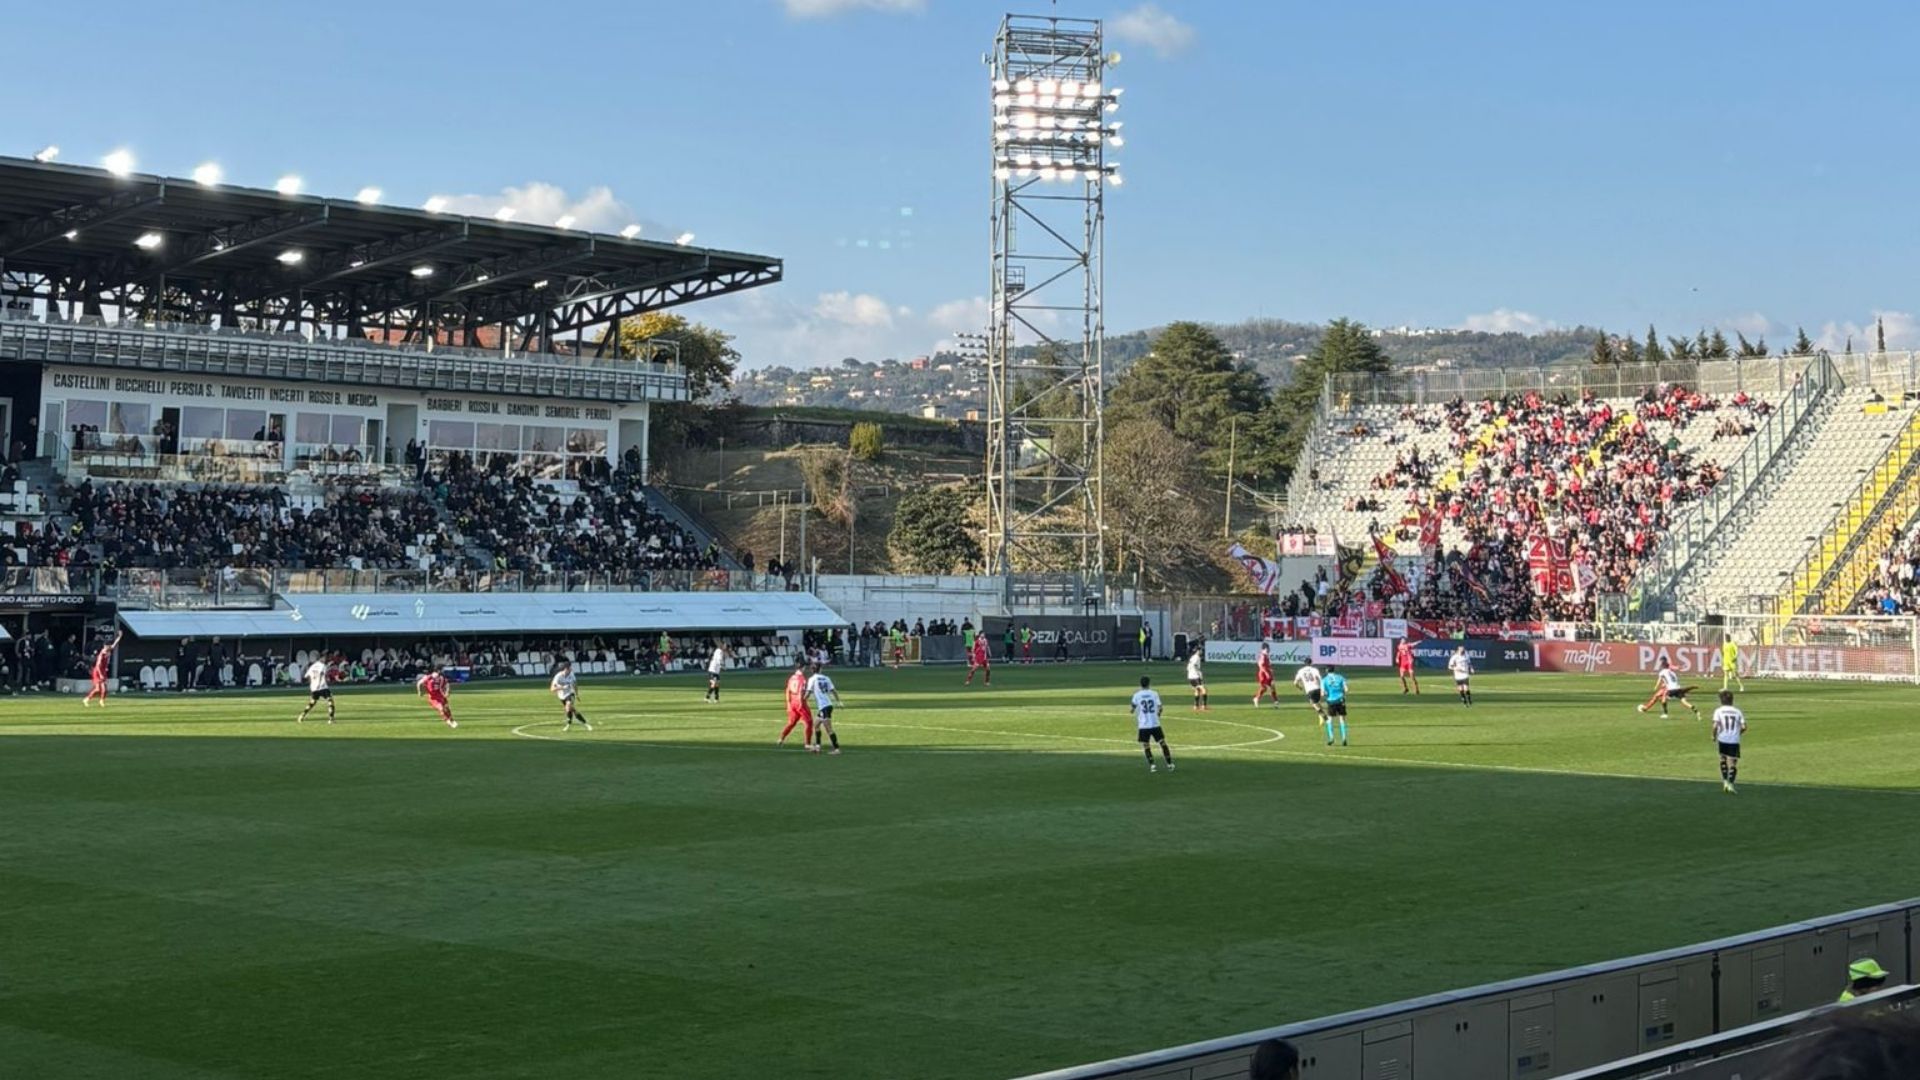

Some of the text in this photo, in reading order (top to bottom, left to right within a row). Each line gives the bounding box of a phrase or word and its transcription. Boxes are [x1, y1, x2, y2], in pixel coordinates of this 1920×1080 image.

[54, 373, 378, 407] CASTELLINI BICCHIELLI PERSIA S. TAVOLETTI INCERTI ROSSI B. MEDICA
[427, 398, 462, 412] BARBIERI
[468, 400, 490, 414] ROSSI
[545, 405, 580, 419] SEMORILE
[585, 408, 612, 421] PERIOLI
[16, 596, 57, 604] ALBERTO
[58, 596, 85, 604] PICCO
[1031, 630, 1060, 644] PEZI
[1319, 645, 1387, 658] BP BENASSI
[1504, 650, 1529, 660] 29:13
[1563, 642, 1612, 672] maffei
[1639, 645, 1844, 674] PASTA MAFFEI
[1141, 699, 1155, 714] 32
[1724, 715, 1736, 731] 17
